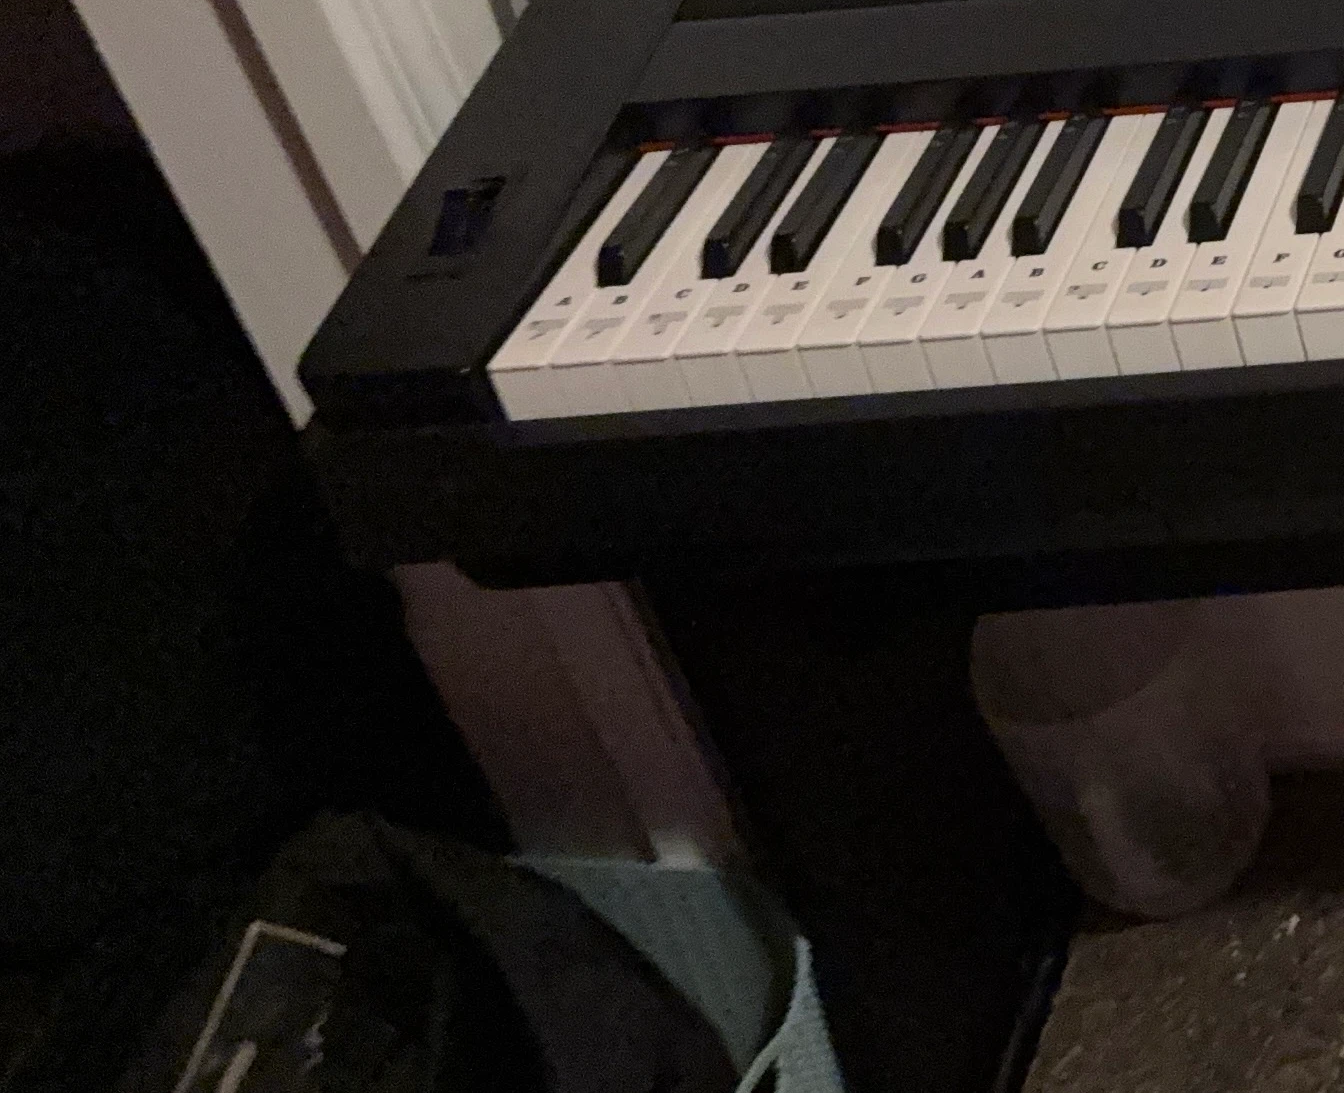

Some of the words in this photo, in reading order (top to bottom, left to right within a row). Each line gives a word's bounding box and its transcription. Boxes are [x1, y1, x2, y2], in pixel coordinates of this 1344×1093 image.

[854, 276, 871, 286] F
[910, 273, 926, 283] G
[970, 269, 984, 278] A
[1029, 267, 1044, 277] B
[1091, 261, 1107, 270] C
[1150, 258, 1167, 268] D
[1210, 255, 1226, 265] E
[1273, 253, 1289, 262] F
